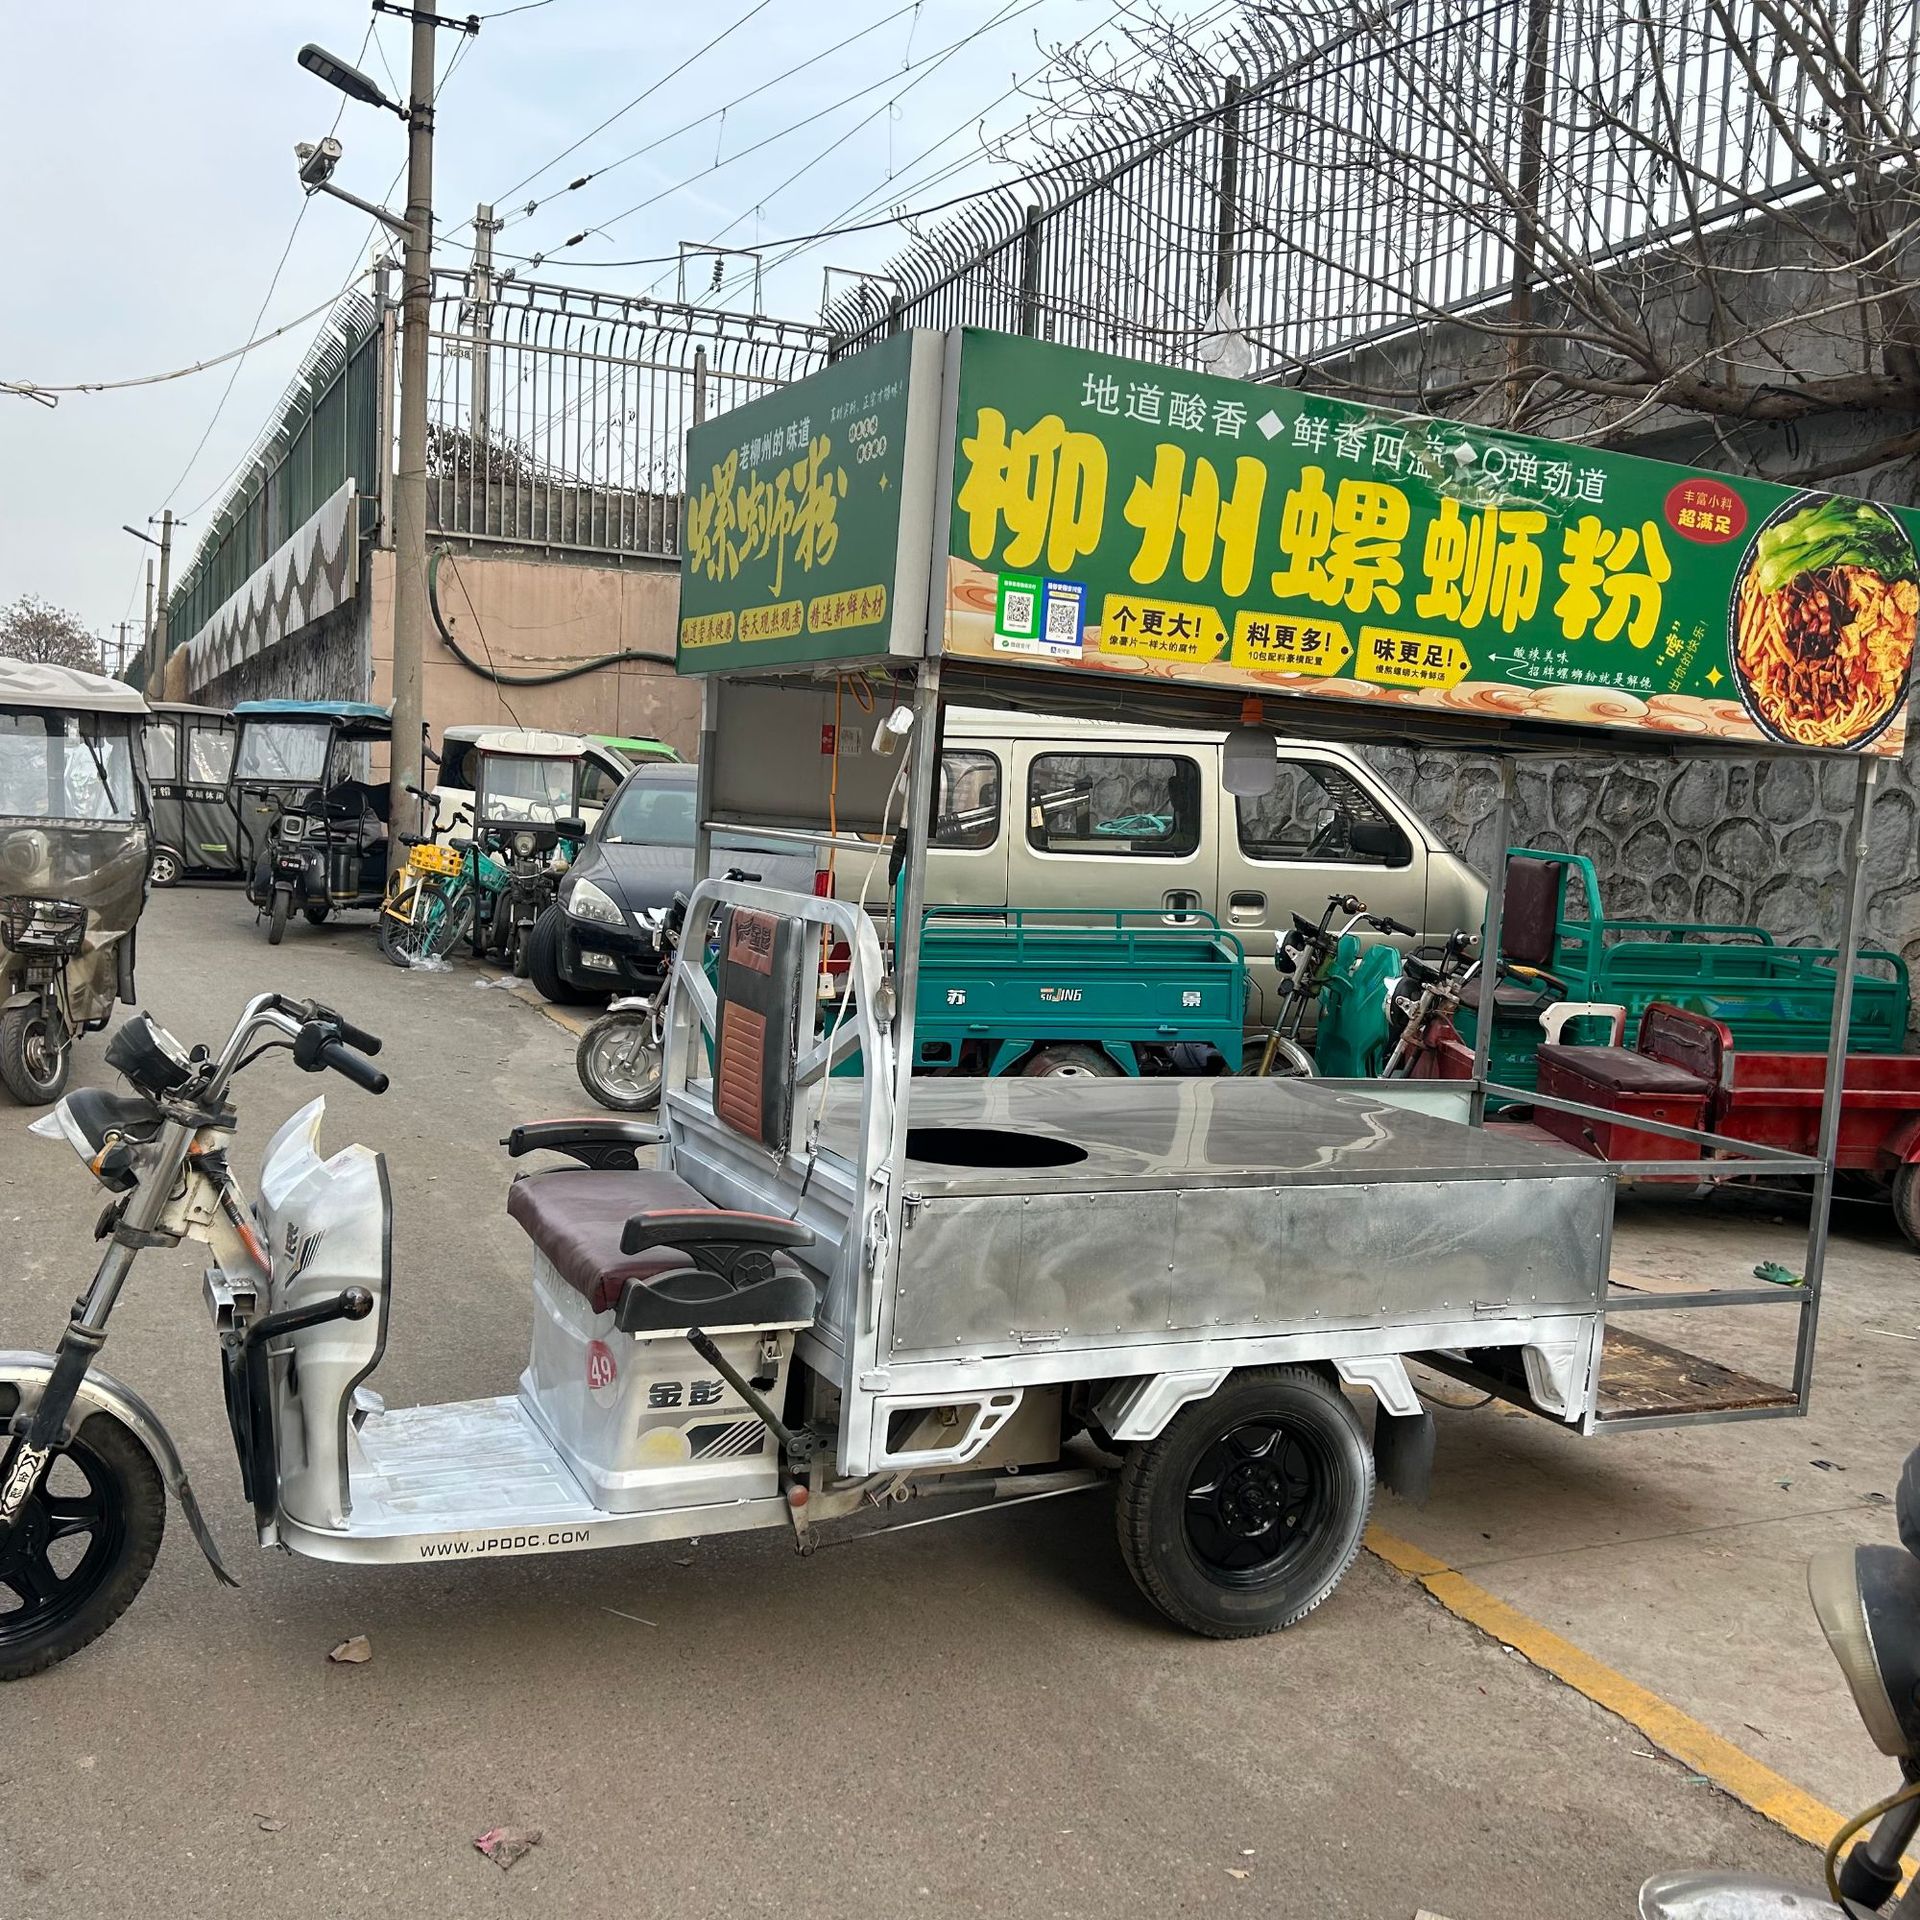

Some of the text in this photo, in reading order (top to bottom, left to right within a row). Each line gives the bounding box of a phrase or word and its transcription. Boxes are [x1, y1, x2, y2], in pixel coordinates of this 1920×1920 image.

[739, 416, 811, 470] 老柳州的味道
[1081, 373, 1608, 504] 地道酸香 鲜香四溢 Q弹劲道
[1683, 489, 1733, 511] 丰富小料
[957, 408, 1672, 650] 柳州螺蛳粉
[1678, 508, 1731, 535] 超满足
[810, 588, 884, 630] 精选新鲜食材
[1112, 605, 1202, 639] 个更大！
[1109, 634, 1198, 655] 像薯片一样大的腐竹
[1247, 621, 1332, 653] 料更多！
[1373, 637, 1453, 668] 味更足！
[1513, 646, 1569, 665] 酸辣美味
[1528, 663, 1652, 690] 招牌螺蛳粉就是解馋
[946, 989, 967, 1005] 苏
[592, 1355, 612, 1386] 49
[647, 1379, 726, 1409] 金彭
[420, 1530, 590, 1557] WWW.JPDDC.COM
